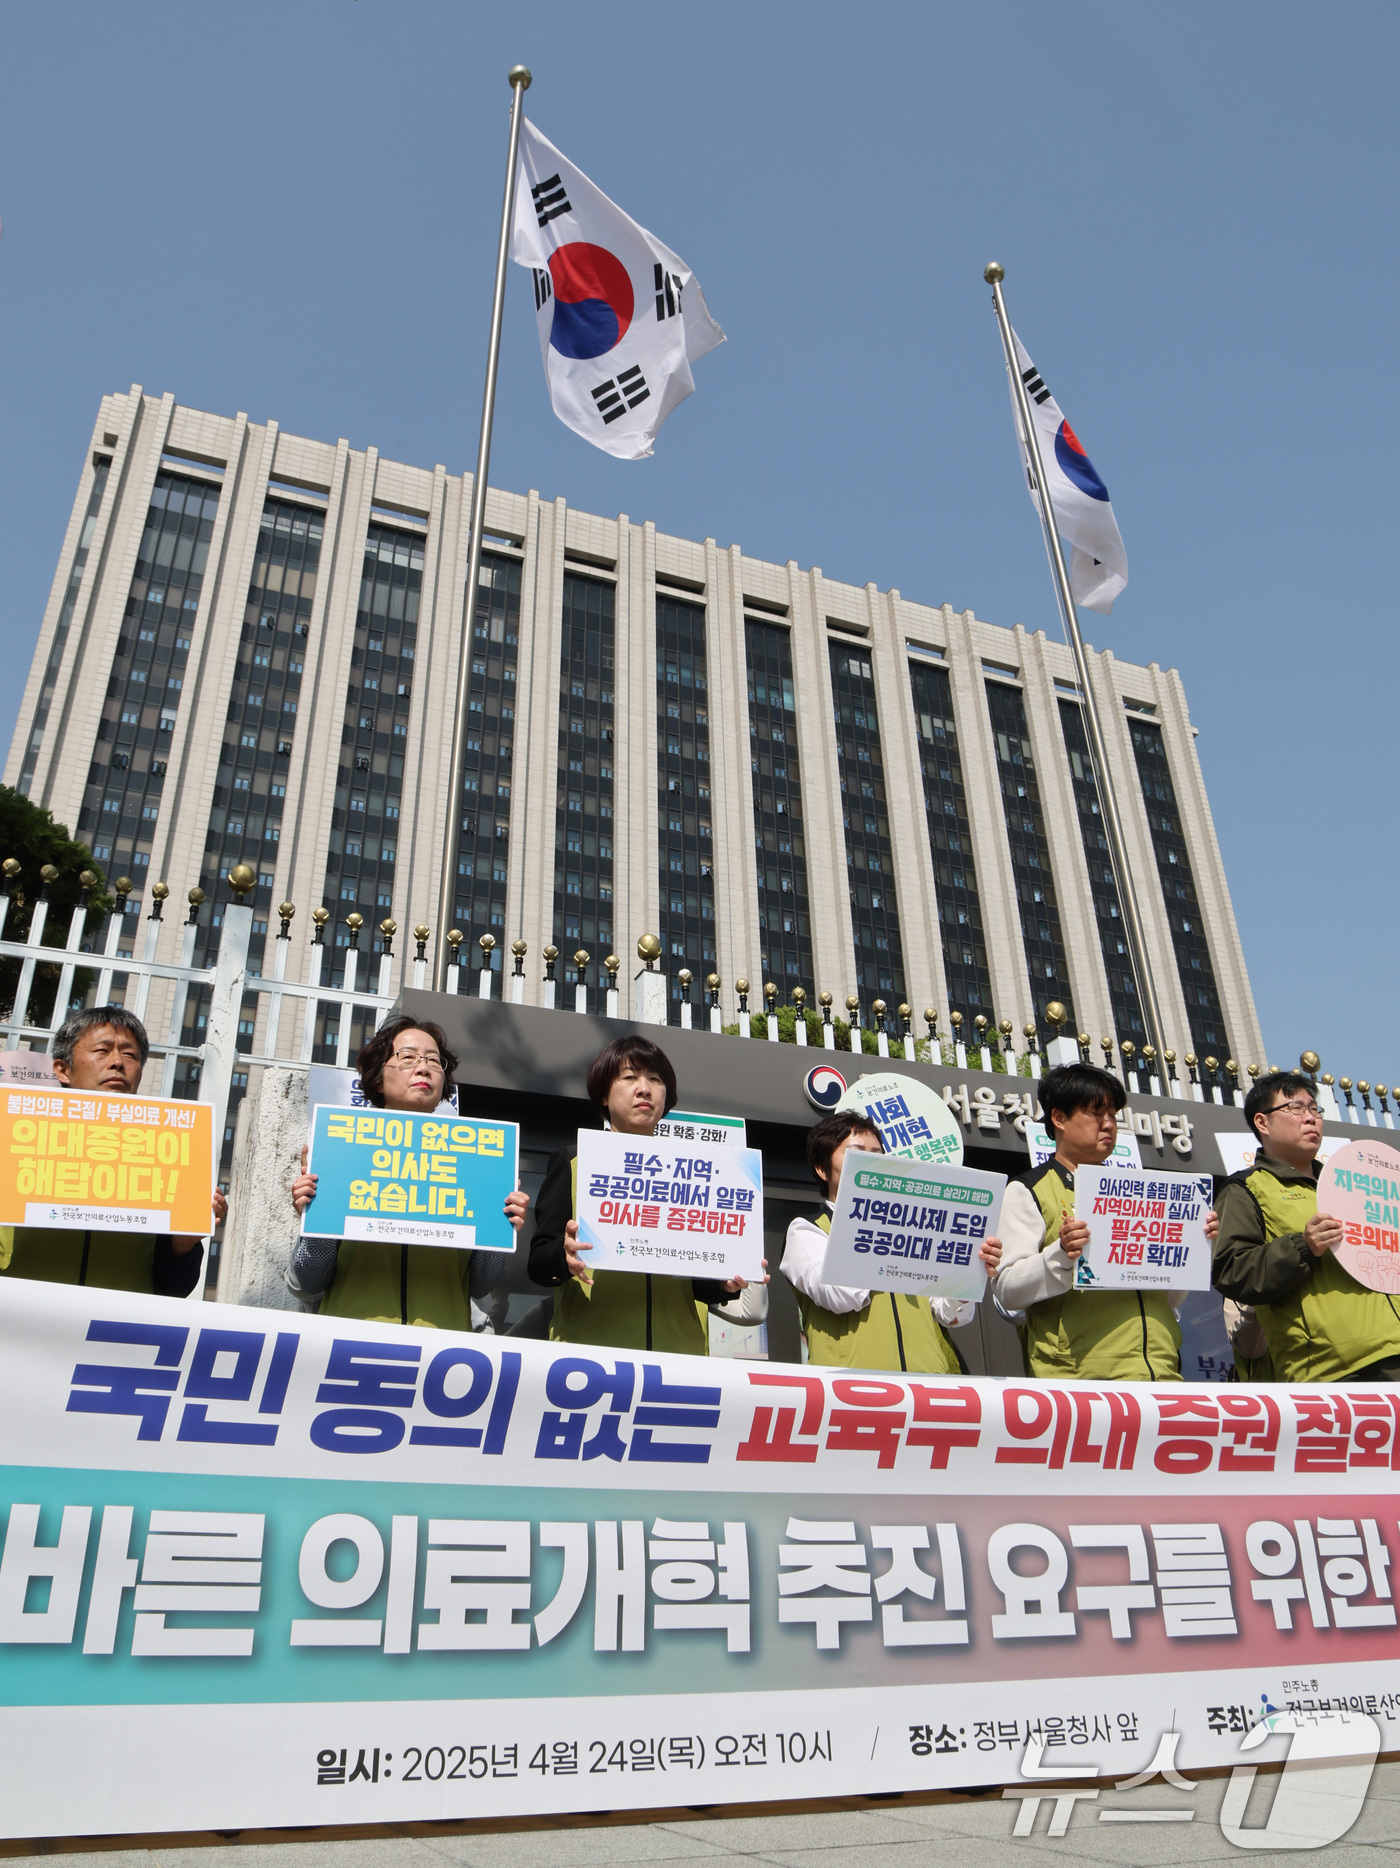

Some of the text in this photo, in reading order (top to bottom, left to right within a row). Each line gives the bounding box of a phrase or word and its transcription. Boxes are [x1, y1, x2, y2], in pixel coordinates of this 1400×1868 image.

[7, 1094, 196, 1129] 불법의료 근절! 부실의료 개선!
[865, 1094, 911, 1125] 사회
[943, 1084, 1045, 1133] 서울청
[10, 1119, 190, 1166] 의대증원이
[327, 1114, 504, 1157] 국민이 없으면
[914, 1134, 960, 1161] 행복한
[16, 1157, 179, 1203] 해답이다!
[370, 1149, 457, 1184] 의사도
[349, 1179, 474, 1218] 없습니다.
[589, 1174, 754, 1212] 공공의료에서 일할
[943, 1187, 970, 1202] 살리기
[972, 1191, 989, 1204] 해법
[1098, 1177, 1196, 1202] 의사인력 쏠림 해결!
[62, 1212, 148, 1224] 전국보건의료산업노동조합
[598, 1200, 746, 1237] 의사를 증원하라
[849, 1197, 988, 1239] 지역의사제 도입
[1092, 1197, 1200, 1221] 지역의사제 실시!
[1364, 1200, 1399, 1229] 실시
[377, 1225, 455, 1239] 전국보건의료산업노동조합
[854, 1228, 973, 1266] 공공의대 설립
[1111, 1218, 1184, 1244] 필수의료
[1333, 1218, 1399, 1253] 공의대
[630, 1246, 725, 1263] 전국보건의료산업노동조합
[1107, 1242, 1189, 1268] 지원 확대!
[65, 1319, 1400, 1474] 국민 동의 없는 교육부 의대 증원 철회
[0, 1503, 1398, 1656] 바른 의료개혁 추진 요구를 위한
[1282, 1679, 1319, 1694] 민주노총
[316, 1693, 1400, 1786] 일시: 2025년 4월 24일(목) 오전 10시 장소: 정부서울청사 앞 주최: 전국보건의료산
